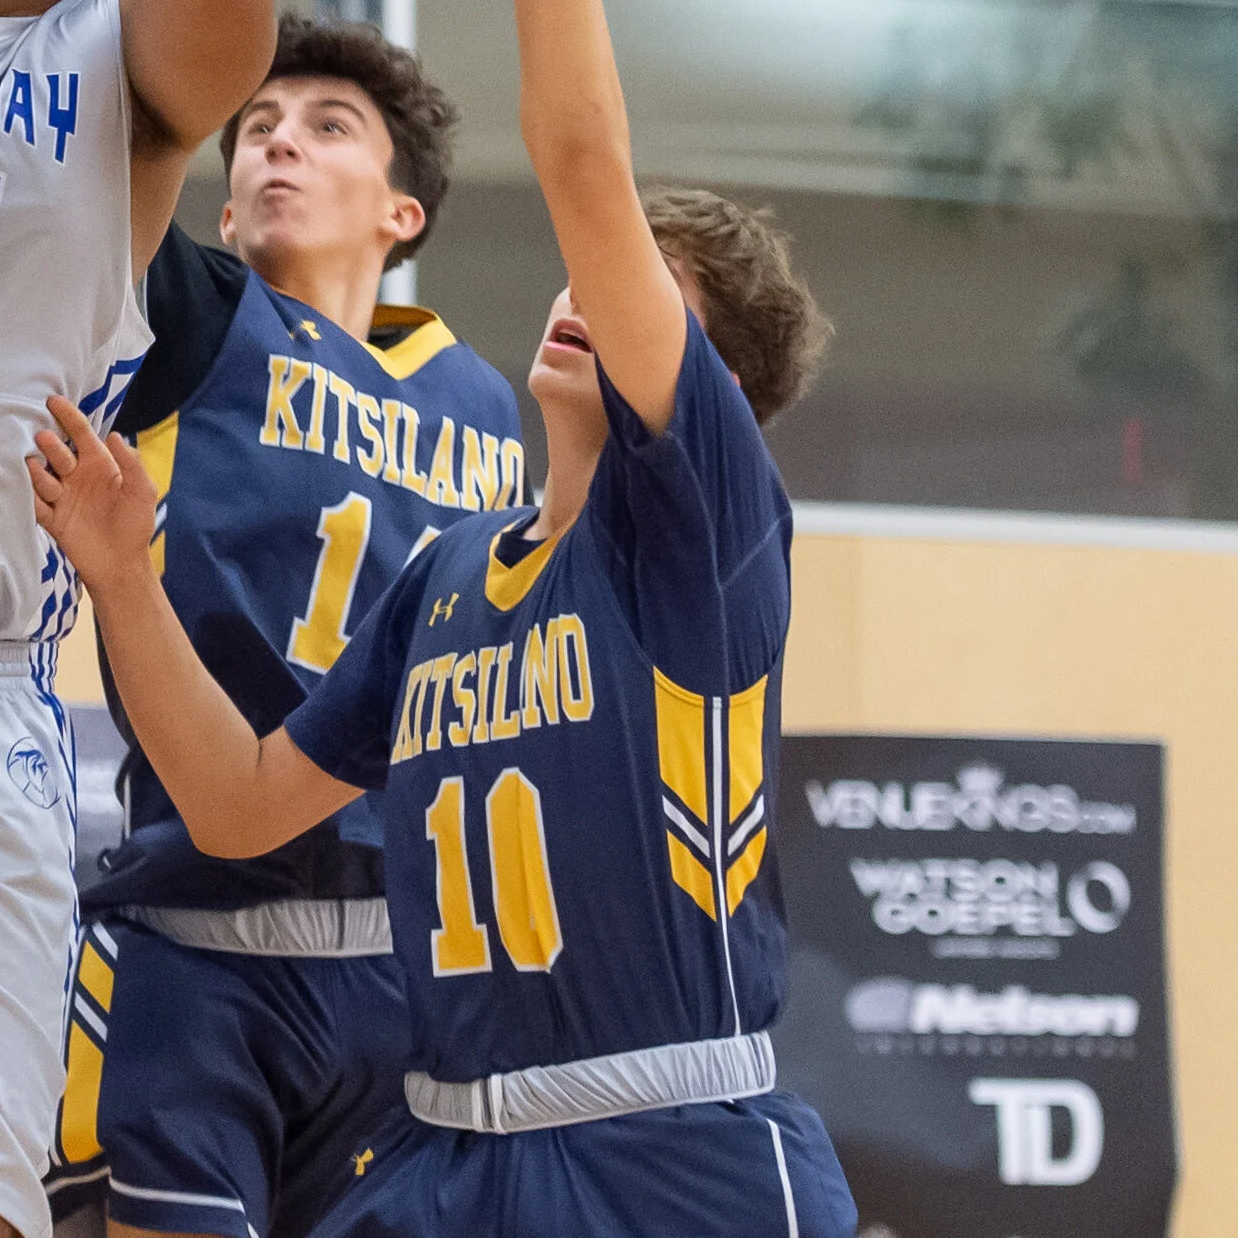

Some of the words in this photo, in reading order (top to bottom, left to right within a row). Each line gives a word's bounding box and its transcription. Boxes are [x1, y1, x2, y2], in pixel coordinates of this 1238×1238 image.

[258, 353, 525, 513] KITSILANO
[389, 613, 595, 765] KITSILNO
[425, 766, 564, 978] 10
[967, 1076, 1106, 1187] TD
